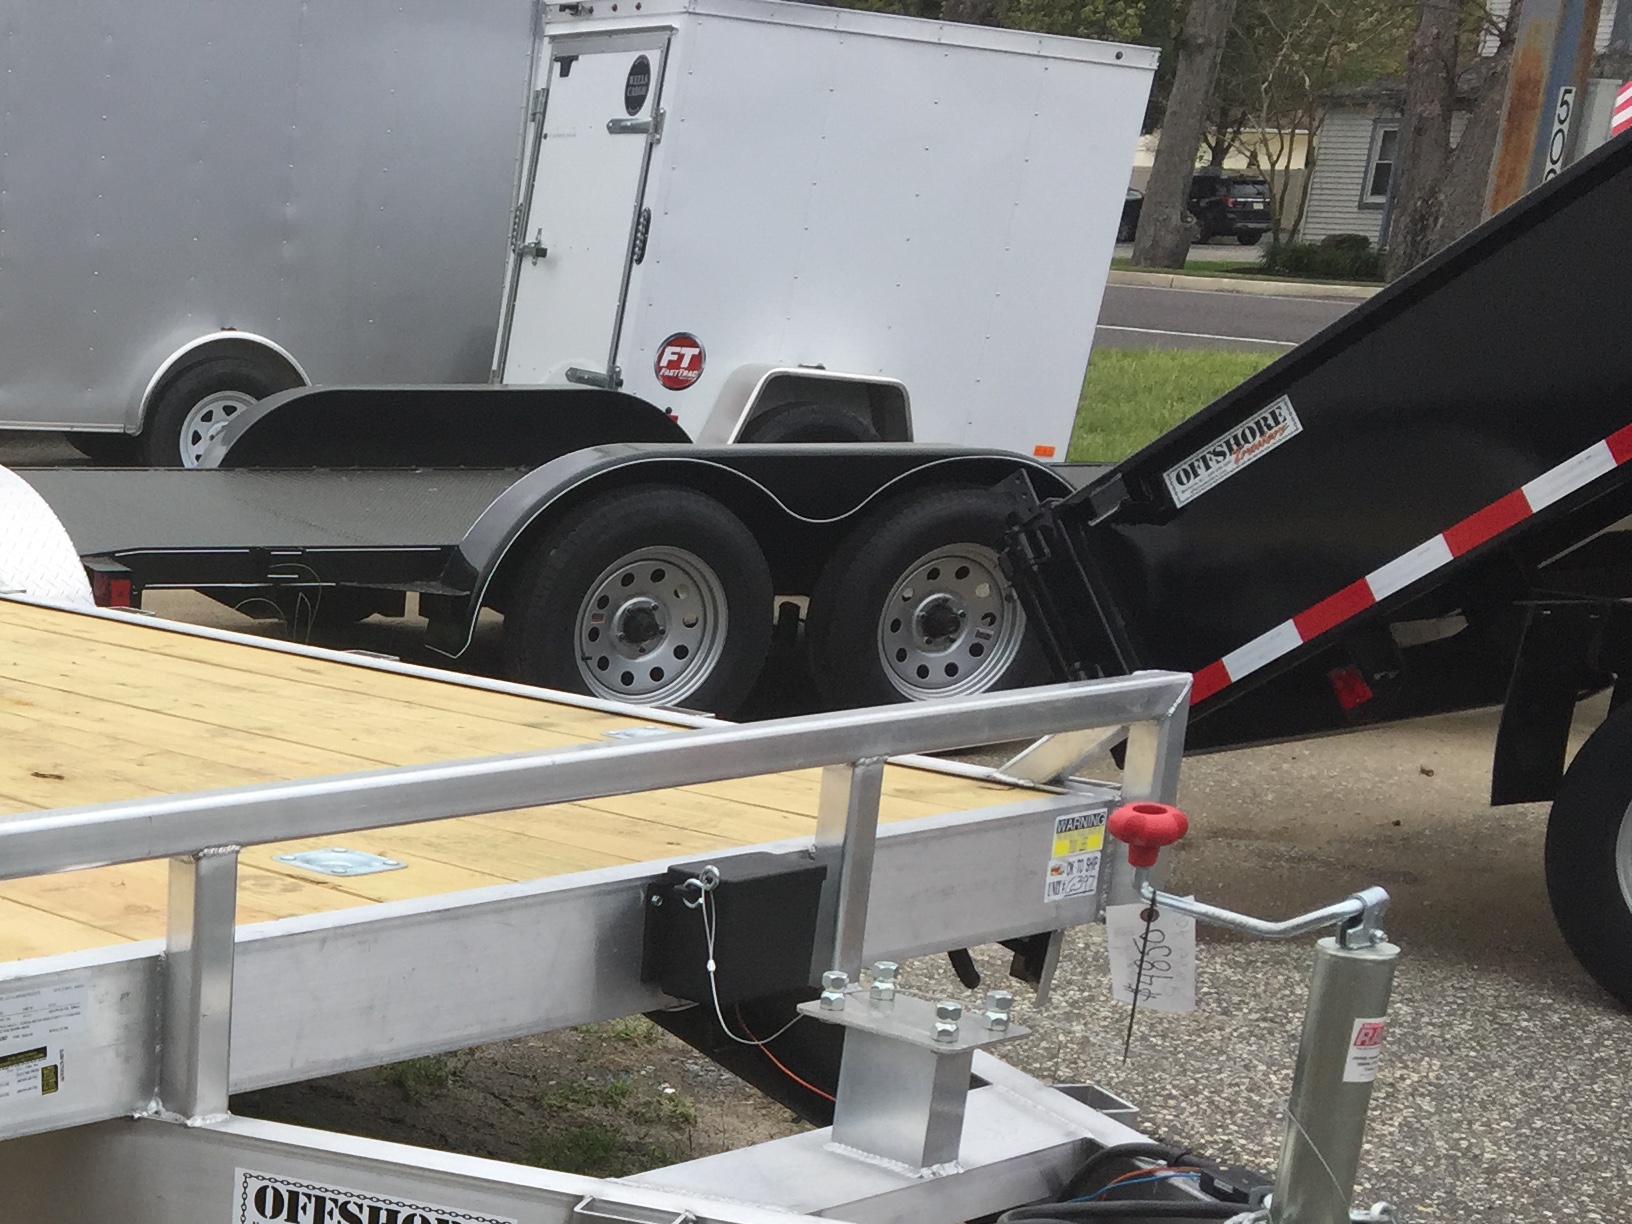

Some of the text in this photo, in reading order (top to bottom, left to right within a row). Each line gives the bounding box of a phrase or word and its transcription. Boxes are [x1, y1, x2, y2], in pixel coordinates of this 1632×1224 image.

[1545, 88, 1573, 181] 50
[659, 345, 701, 368] FT
[1175, 405, 1288, 487] OFFSHORE
[1056, 812, 1106, 833] WARNING
